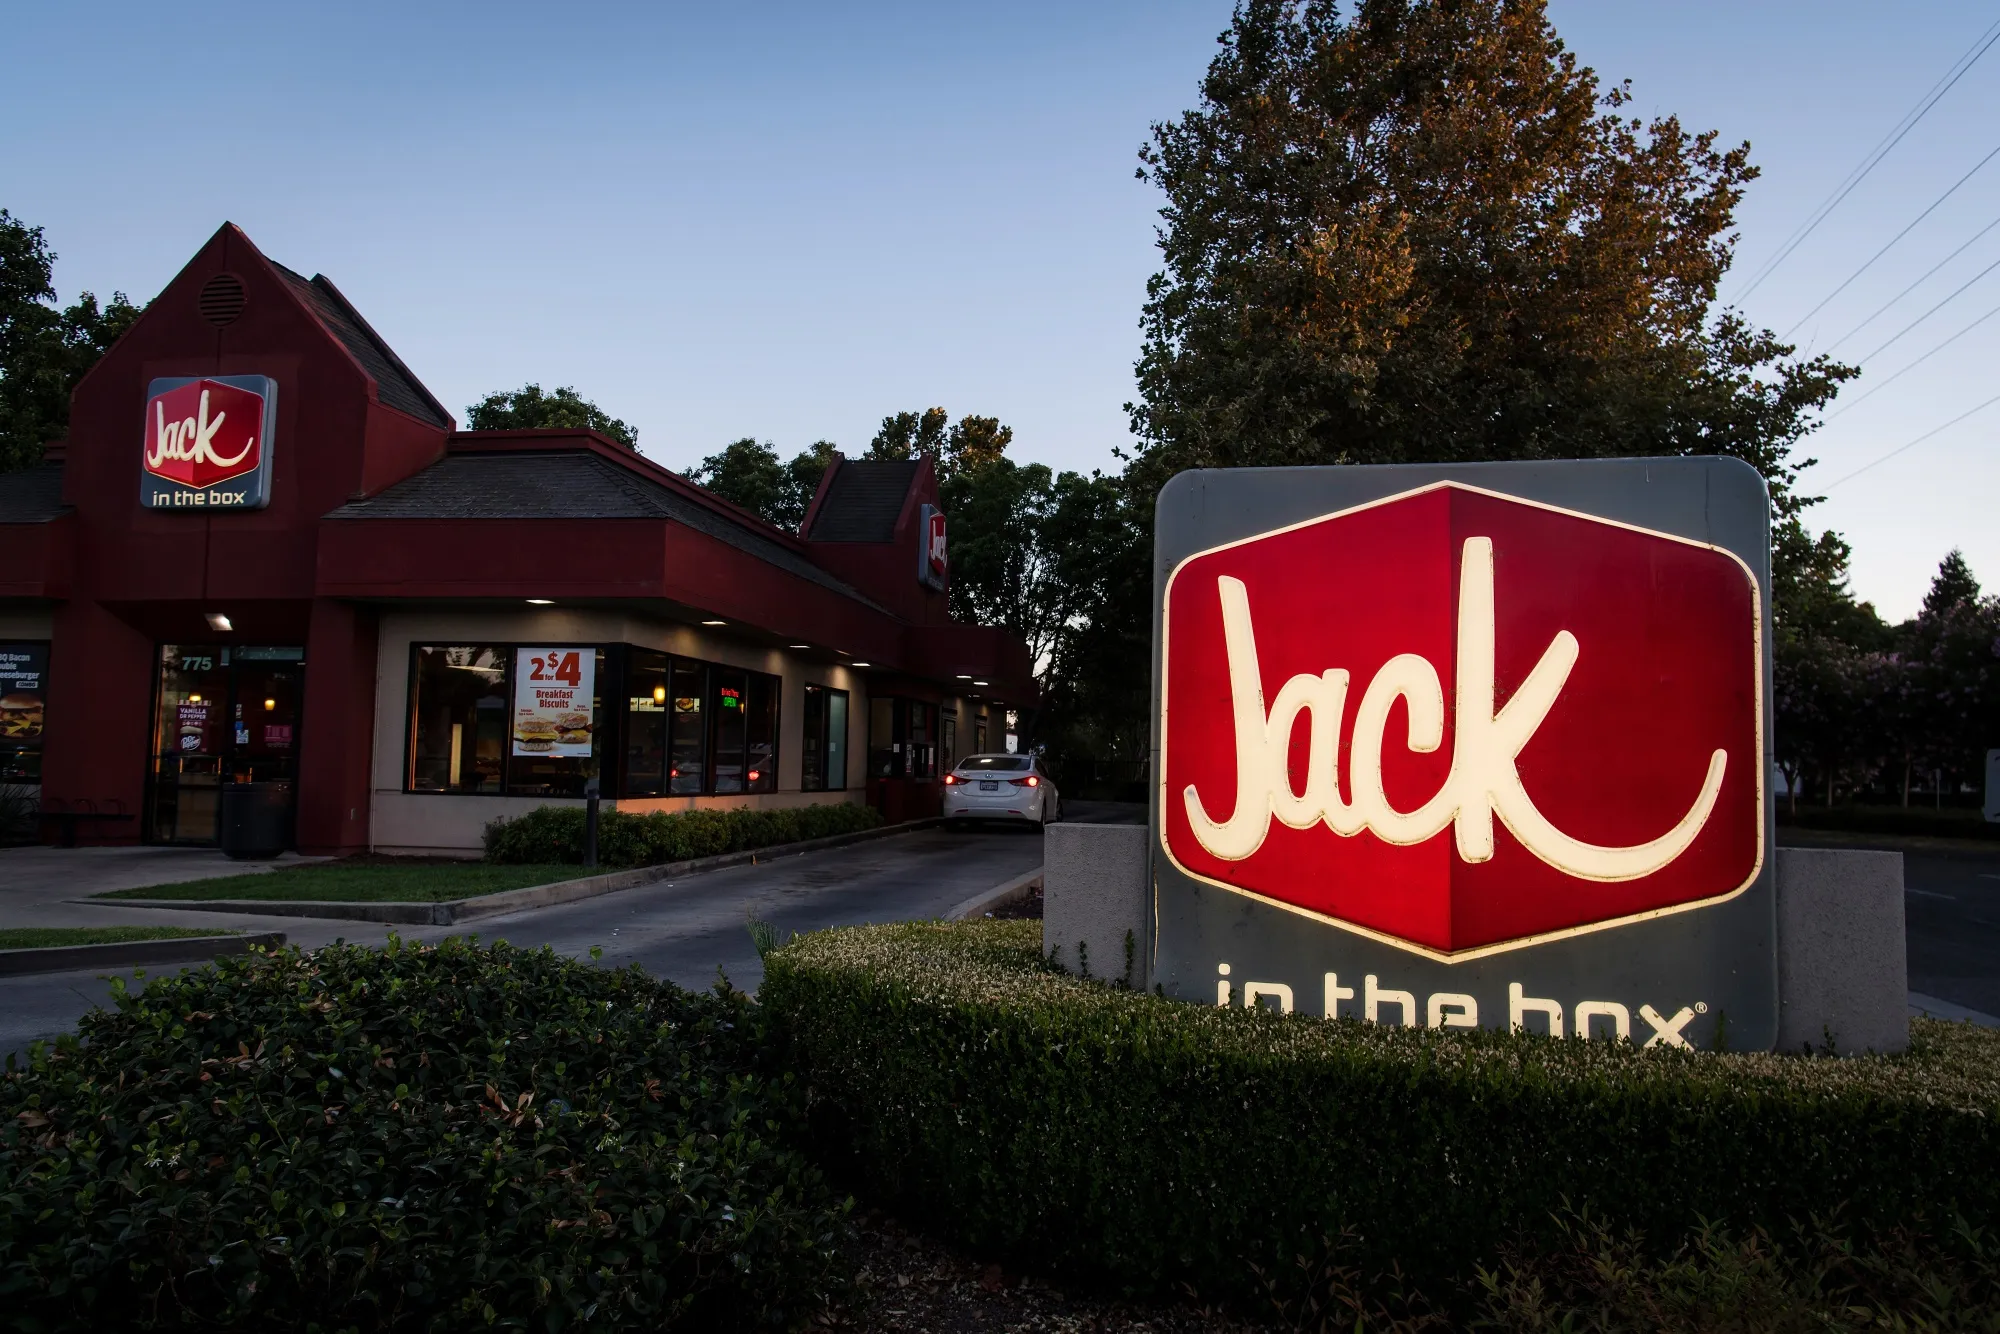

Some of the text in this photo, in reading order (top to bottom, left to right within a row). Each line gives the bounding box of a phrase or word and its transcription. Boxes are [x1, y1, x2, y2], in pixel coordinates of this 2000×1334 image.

[147, 389, 254, 468] Jack
[152, 489, 245, 507] in the box
[8, 653, 31, 662] Bacon
[181, 656, 213, 671] 775
[529, 657, 545, 680] 2
[545, 673, 554, 681] for
[536, 689, 573, 699] Breakfast
[723, 696, 737, 707] OPEN
[179, 707, 207, 715] VANILLA
[539, 699, 570, 709] Biscuits
[1183, 536, 1729, 884] Jack
[1218, 963, 1294, 1015] in
[1324, 972, 1478, 1029] the
